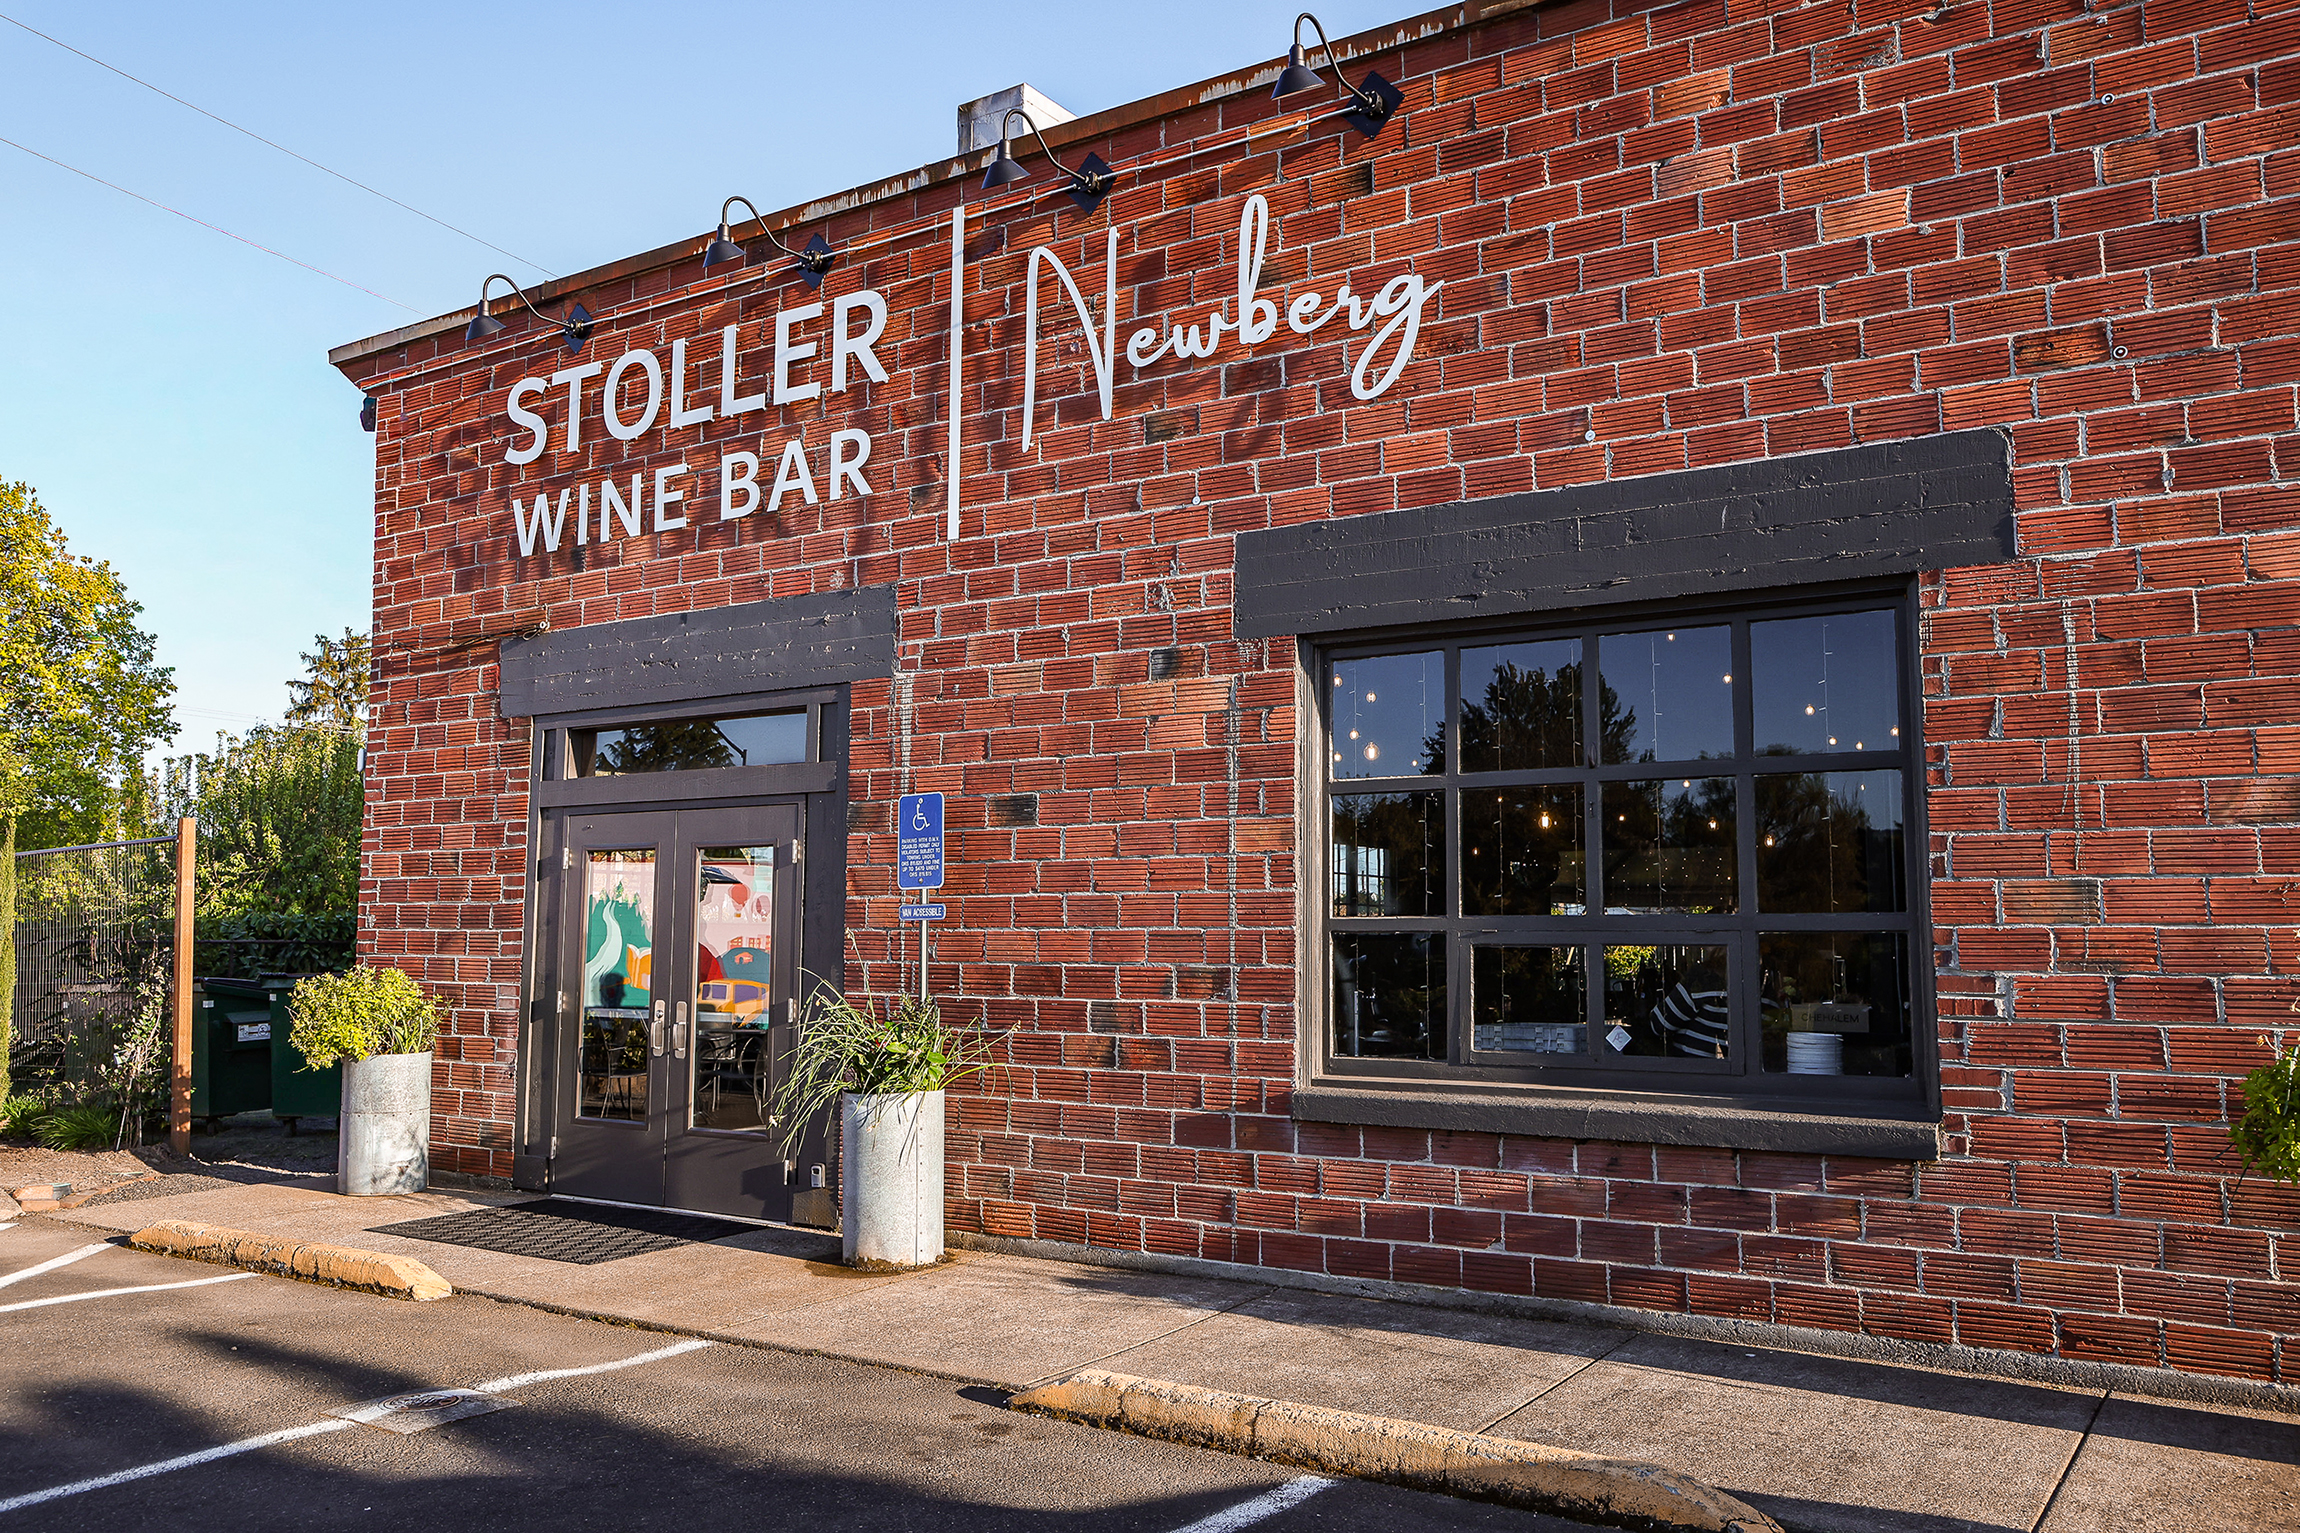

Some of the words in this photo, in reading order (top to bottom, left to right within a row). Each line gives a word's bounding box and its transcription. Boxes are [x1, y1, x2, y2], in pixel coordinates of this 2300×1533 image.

[504, 290, 889, 466] STOLLER
[1022, 194, 1445, 454] Newberg
[512, 463, 688, 557] WINE
[720, 428, 874, 521] BAR
[902, 908, 912, 917] VAN
[912, 907, 942, 917] ACCESSIBLE
[1801, 1012, 1860, 1023] CHEHALEM
